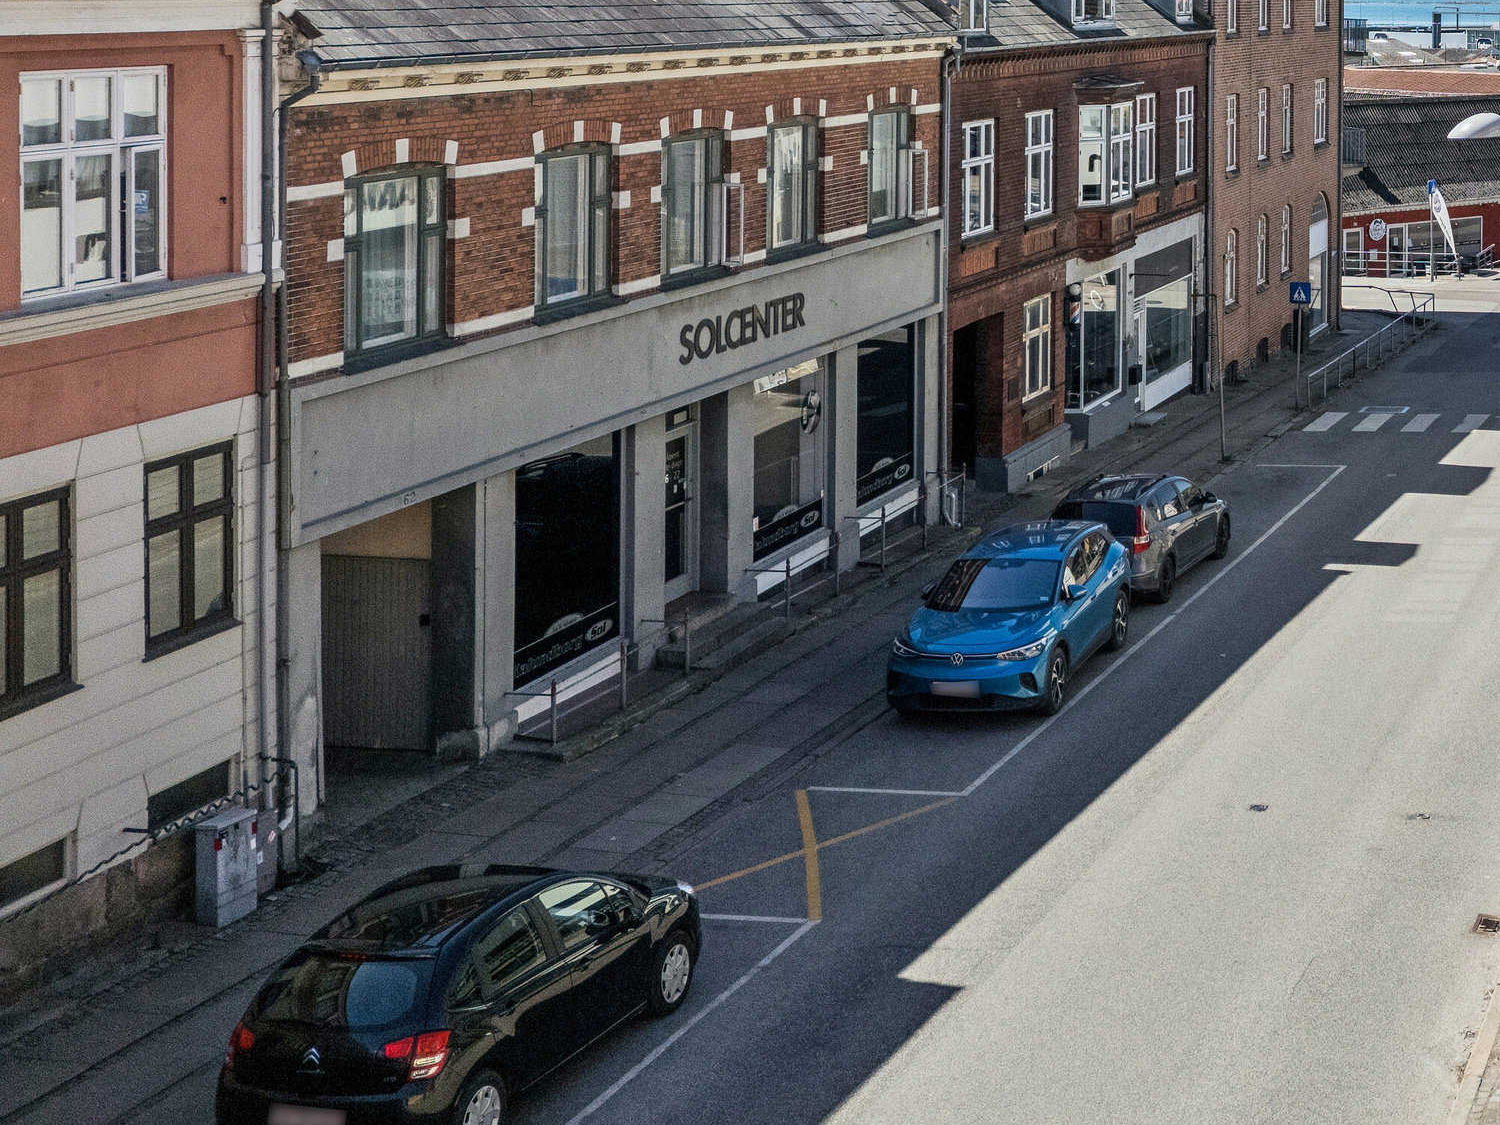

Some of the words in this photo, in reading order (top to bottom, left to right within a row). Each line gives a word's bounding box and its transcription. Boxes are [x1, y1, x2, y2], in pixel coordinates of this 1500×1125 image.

[679, 292, 806, 365] SOLCENTER
[403, 491, 416, 505] 62
[590, 621, 608, 639] Sol
